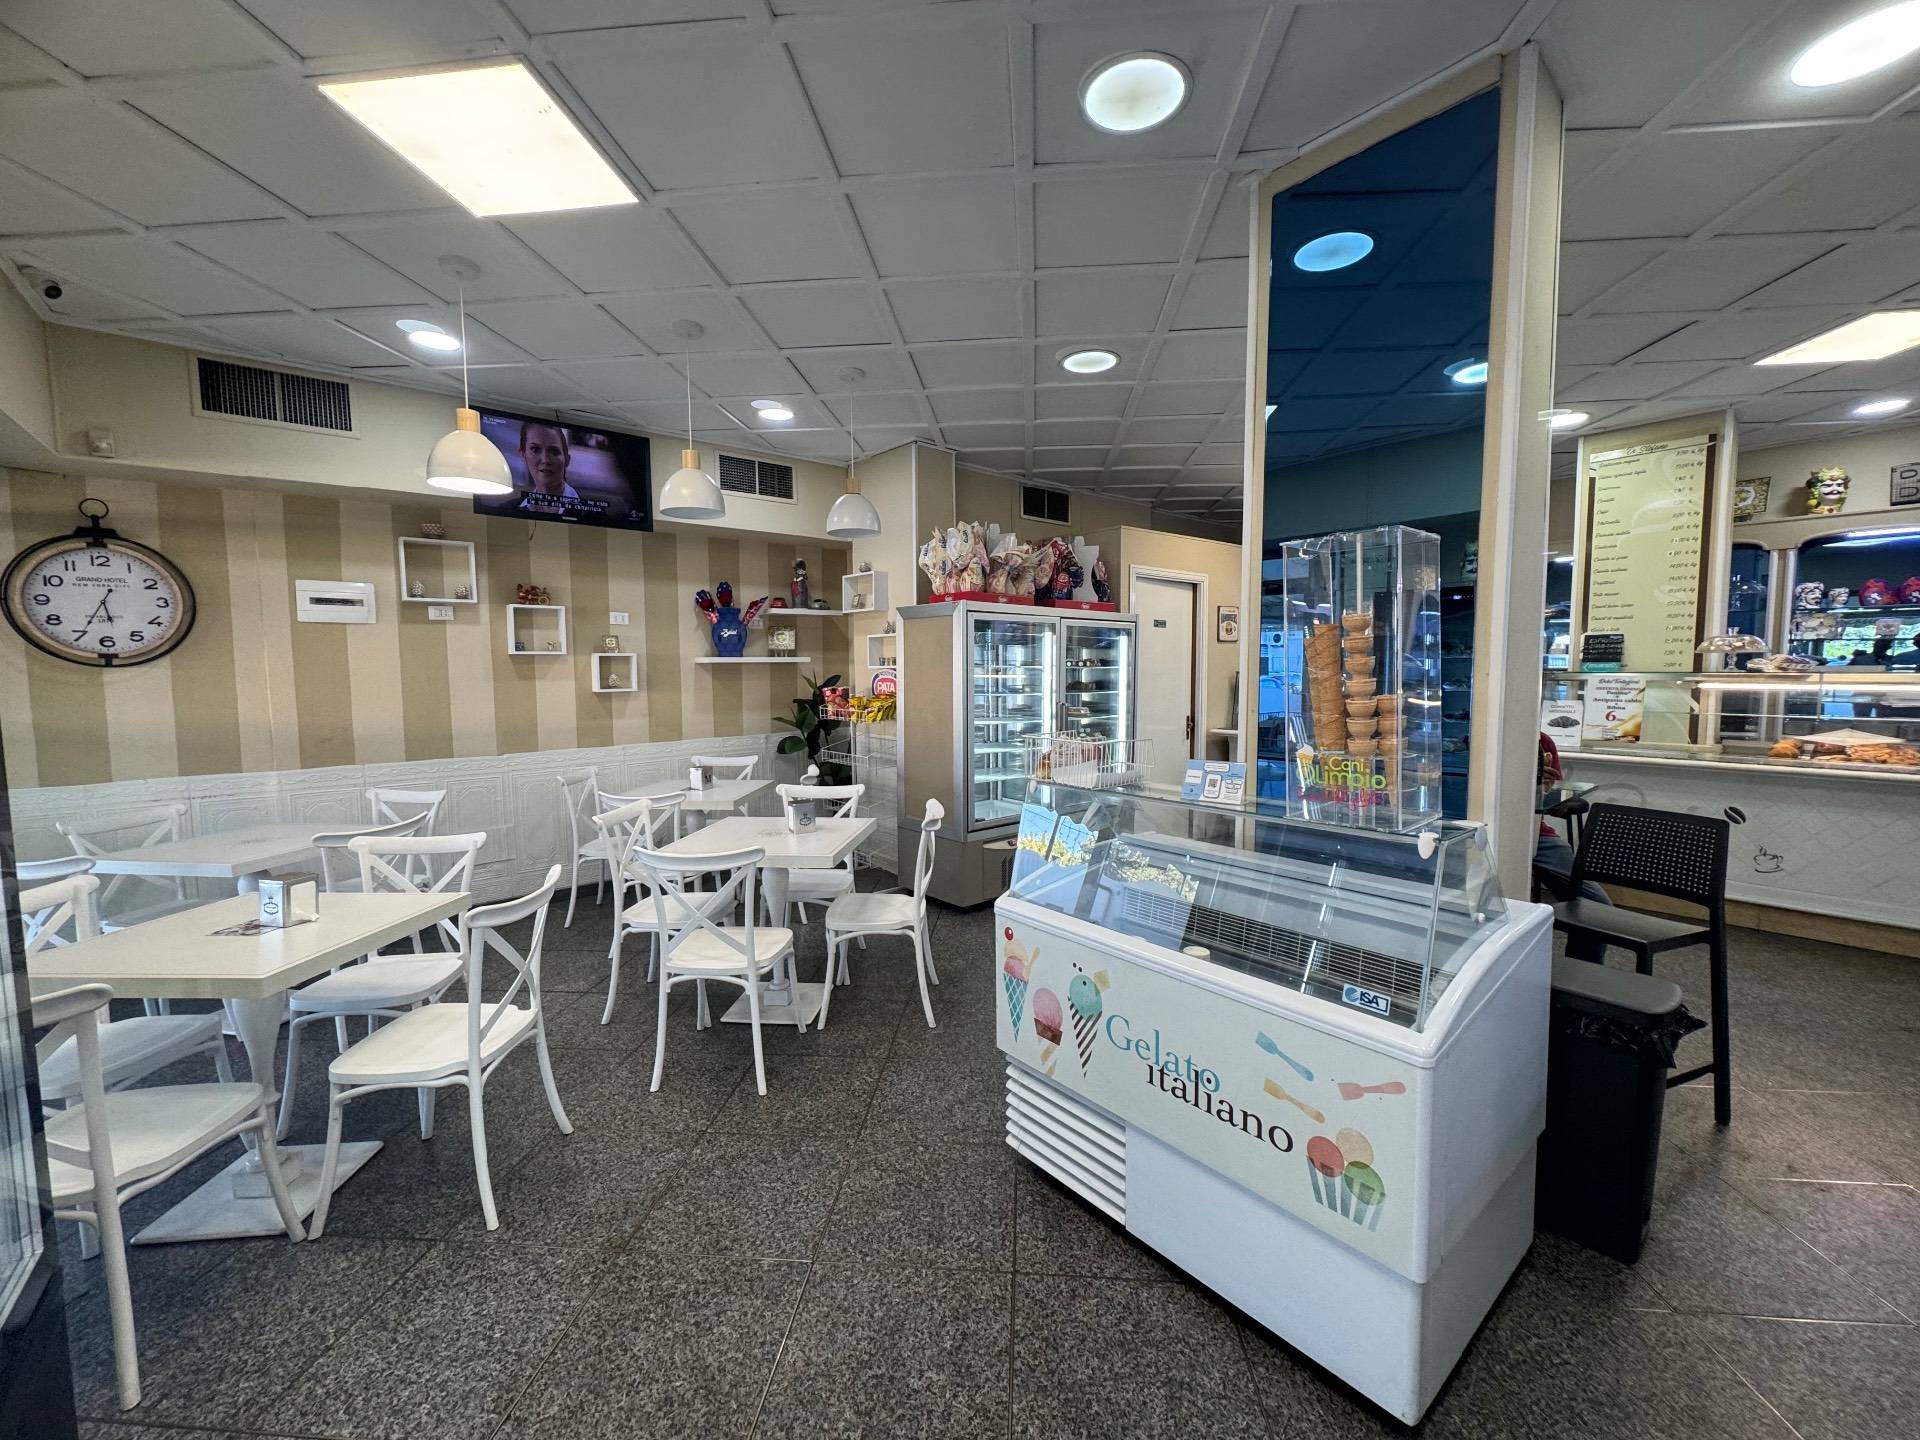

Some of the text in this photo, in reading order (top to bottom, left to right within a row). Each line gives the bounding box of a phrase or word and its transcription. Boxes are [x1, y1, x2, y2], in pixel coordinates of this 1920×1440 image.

[64, 560, 76, 572] 11
[90, 555, 110, 567] 12
[127, 563, 132, 574] 1
[43, 575, 64, 587] 10
[143, 579, 158, 590] 2
[34, 594, 50, 606] 9
[156, 598, 170, 609] 3
[45, 614, 63, 626] 8
[148, 616, 164, 627] 4
[71, 630, 88, 642] 7
[99, 636, 116, 648] 6
[130, 631, 144, 642] 5
[877, 681, 895, 693] PATA
[1605, 710, 1617, 721] 6
[1360, 990, 1380, 1007] ISA
[1105, 1013, 1220, 1094] Gelato
[1146, 1063, 1295, 1154] italiano
